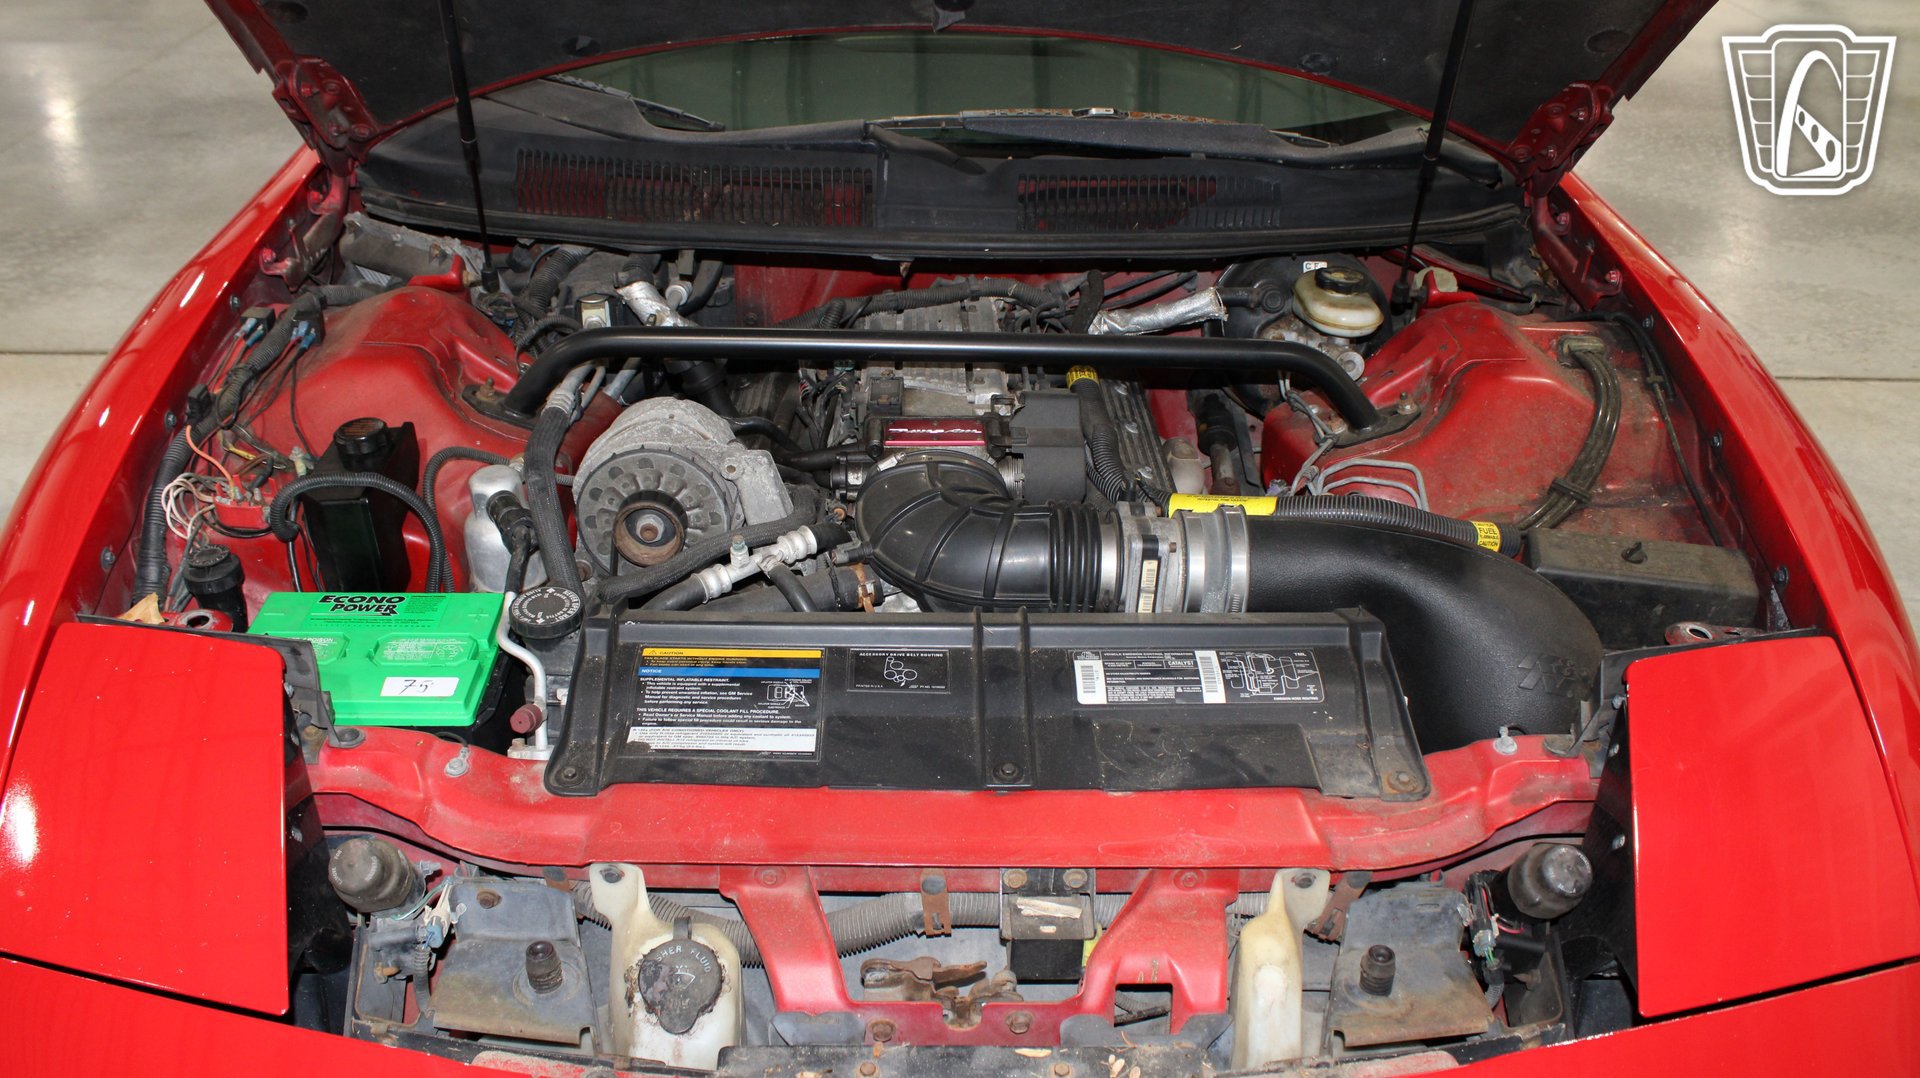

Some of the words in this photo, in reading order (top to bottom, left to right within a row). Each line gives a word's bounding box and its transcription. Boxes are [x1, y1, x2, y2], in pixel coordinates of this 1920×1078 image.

[1478, 527, 1498, 535] FUEL
[319, 595, 406, 604] ECONO
[330, 603, 399, 616] POWER
[690, 948, 713, 974] FLUID
